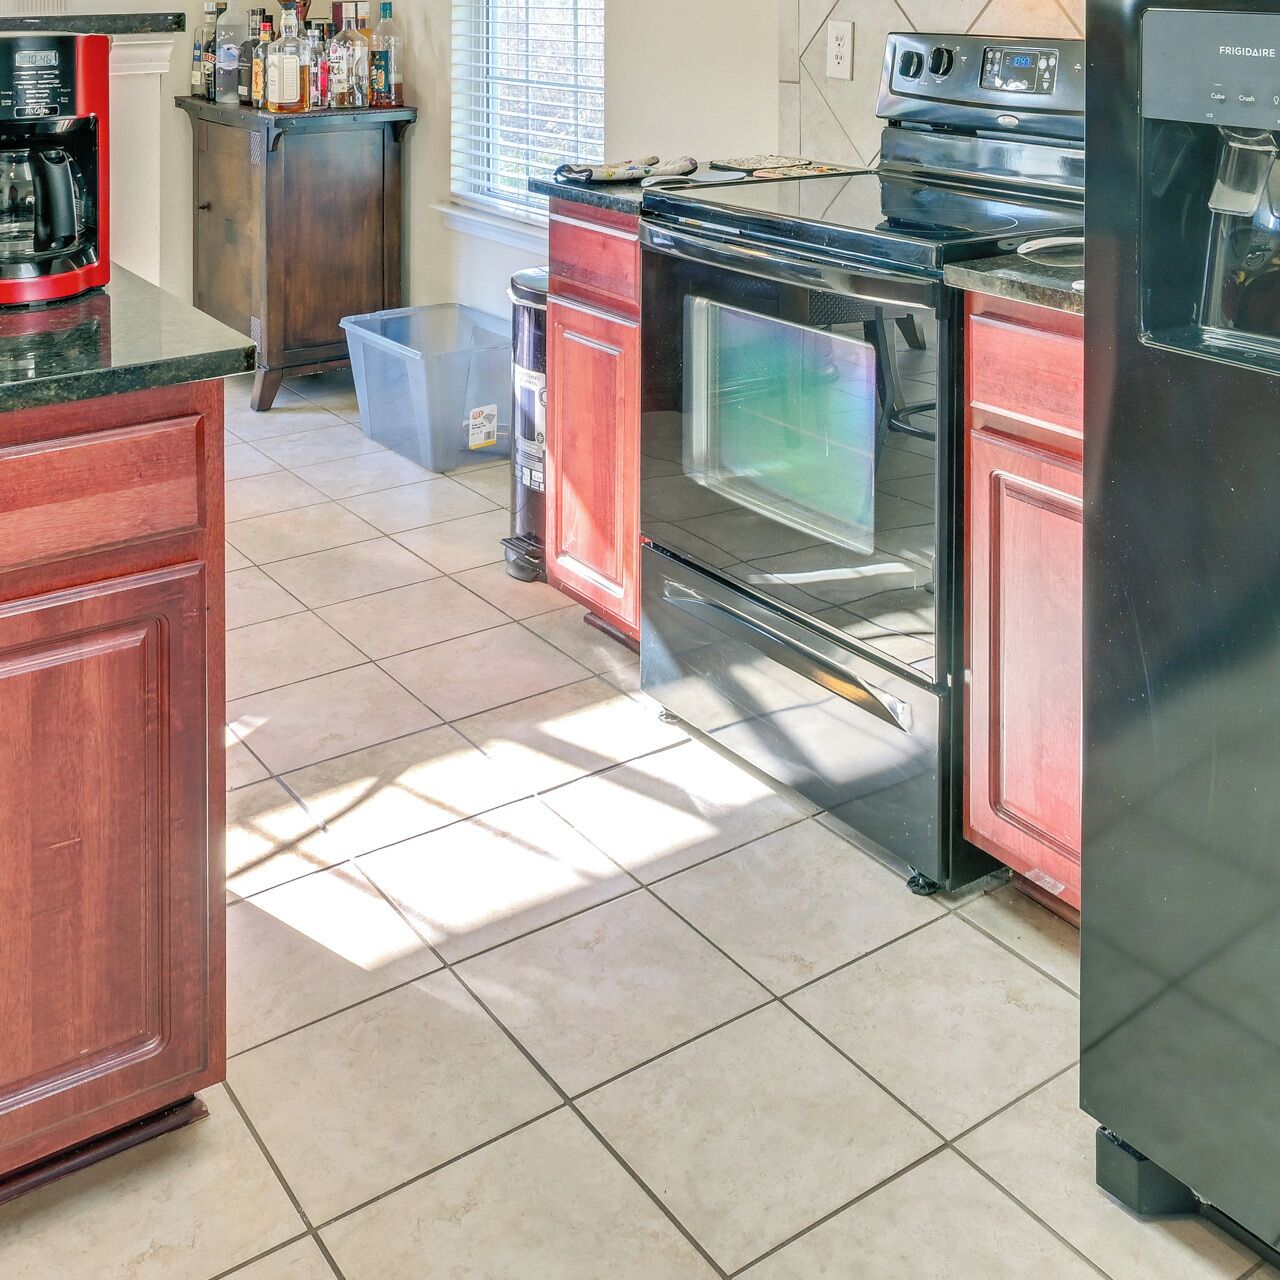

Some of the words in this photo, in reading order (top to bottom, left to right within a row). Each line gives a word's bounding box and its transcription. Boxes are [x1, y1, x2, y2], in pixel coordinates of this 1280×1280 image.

[1219, 46, 1276, 57] FRIGIDAIRE
[1210, 92, 1225, 100] Cube
[1239, 94, 1255, 102] Crush
